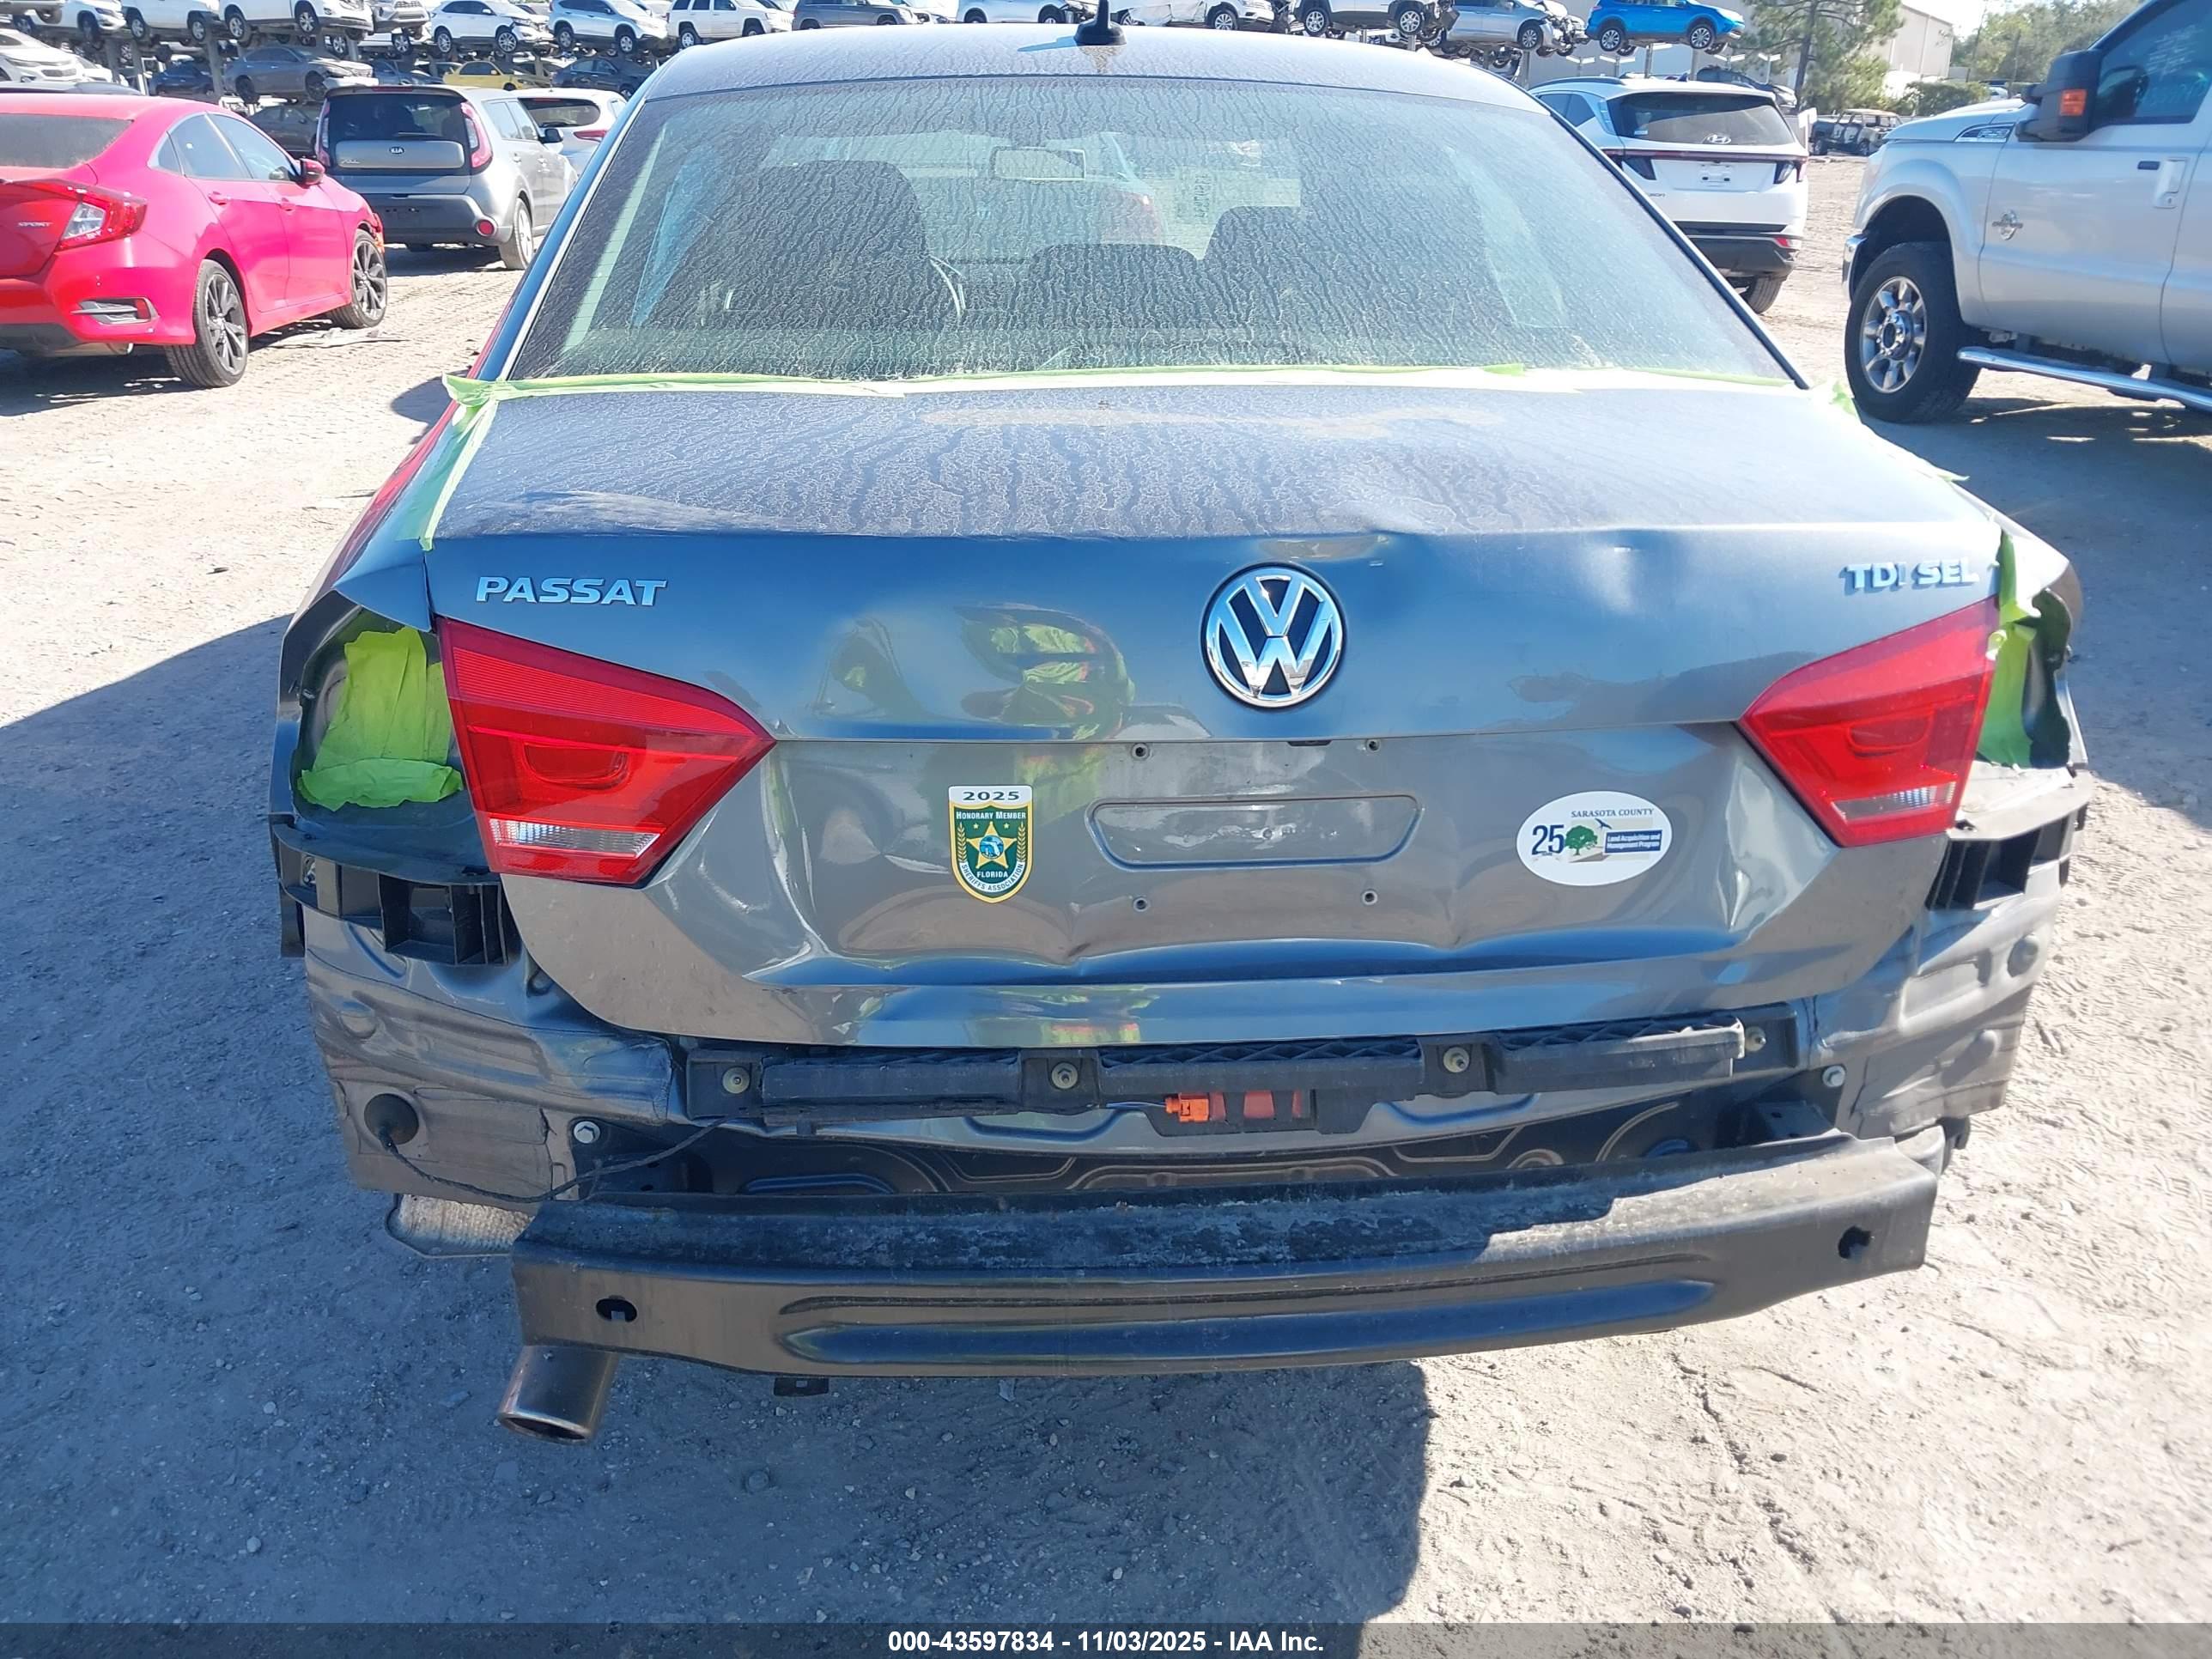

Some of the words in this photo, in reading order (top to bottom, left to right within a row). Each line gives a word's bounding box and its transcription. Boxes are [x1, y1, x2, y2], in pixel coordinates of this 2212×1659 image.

[1844, 562, 1906, 591] TDI
[1913, 559, 1979, 587] SEL
[475, 576, 668, 606] PASSAT
[1206, 568, 1344, 708] VW
[963, 791, 1020, 801] 2025
[956, 811, 994, 819] HONORARY
[995, 811, 1027, 819] MEMBER
[1571, 810, 1617, 818] SARASOTA
[1618, 808, 1655, 817] COUNTY
[1531, 823, 1565, 855] 25
[961, 864, 986, 890] SHERIFFS
[988, 864, 1024, 891] ASSOCIATION
